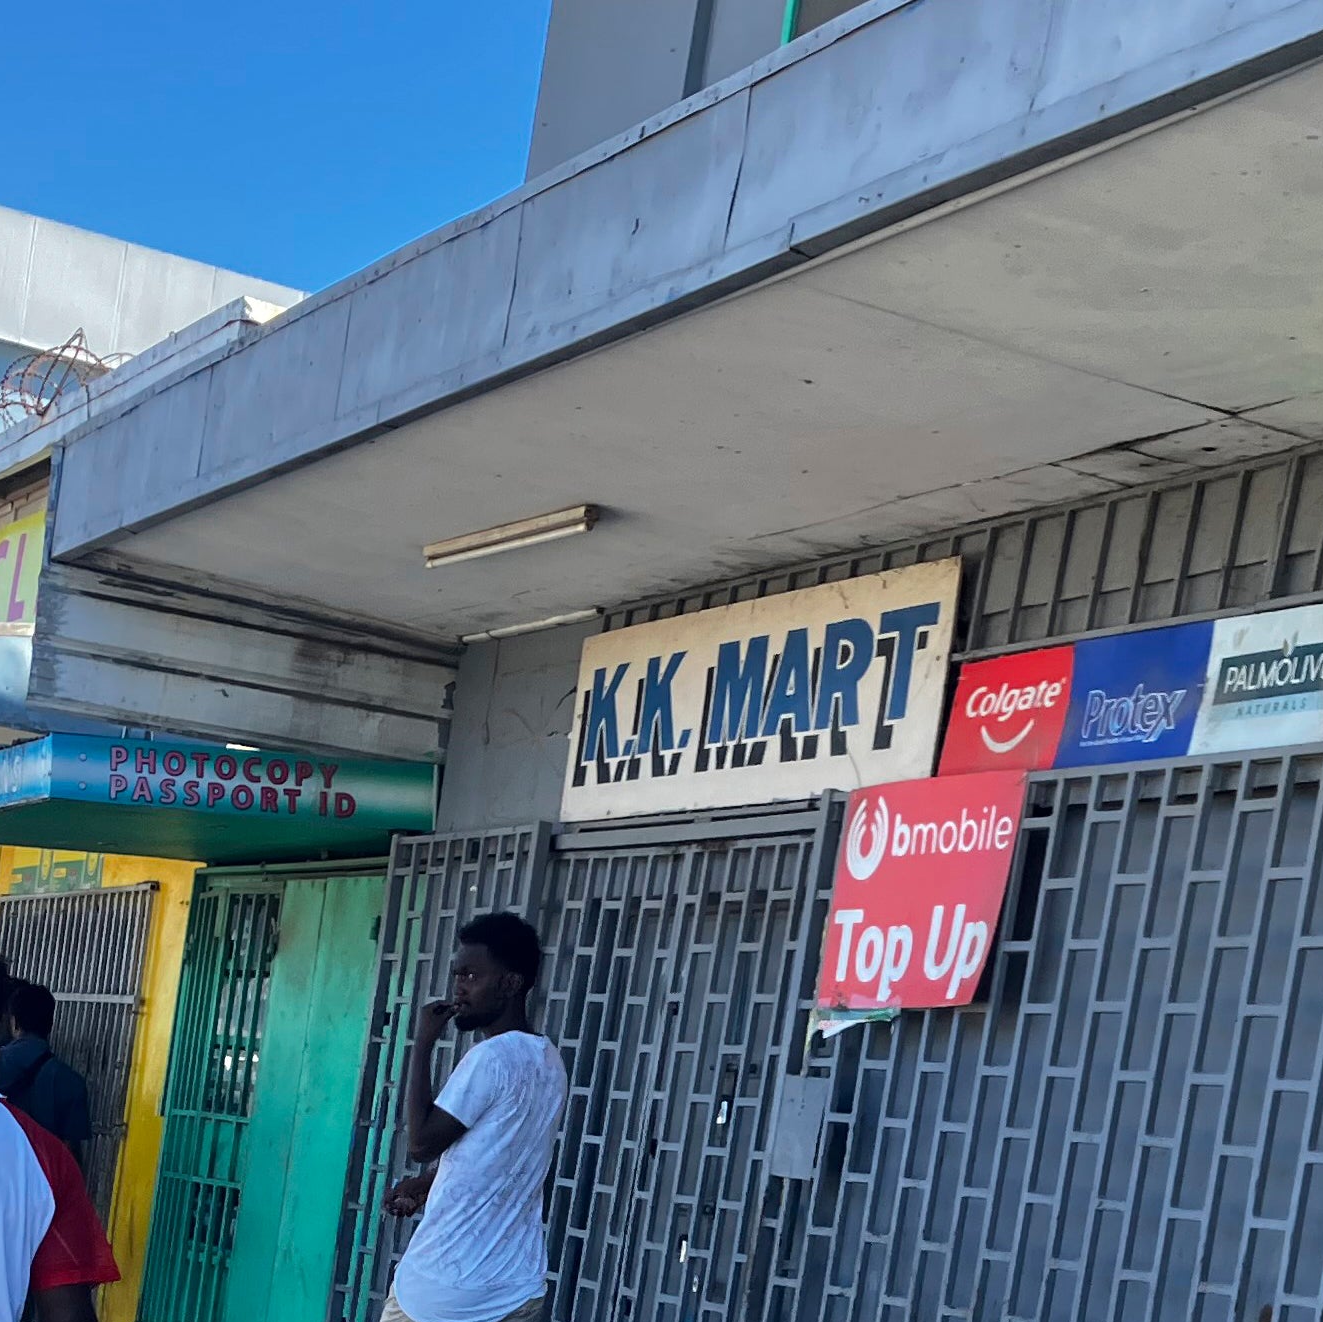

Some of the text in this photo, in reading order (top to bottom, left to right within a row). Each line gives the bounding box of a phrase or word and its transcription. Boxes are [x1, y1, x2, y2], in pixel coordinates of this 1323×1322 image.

[573, 601, 941, 787] K.K. MART
[965, 679, 1063, 722] Colgate
[1081, 683, 1188, 743] Protex
[1235, 697, 1308, 717] NATURALS
[109, 744, 339, 790] PHOTOCOPY
[108, 773, 357, 819] PASSPORT ID
[891, 804, 1014, 858] bmobile
[834, 903, 989, 1003] Top Up
